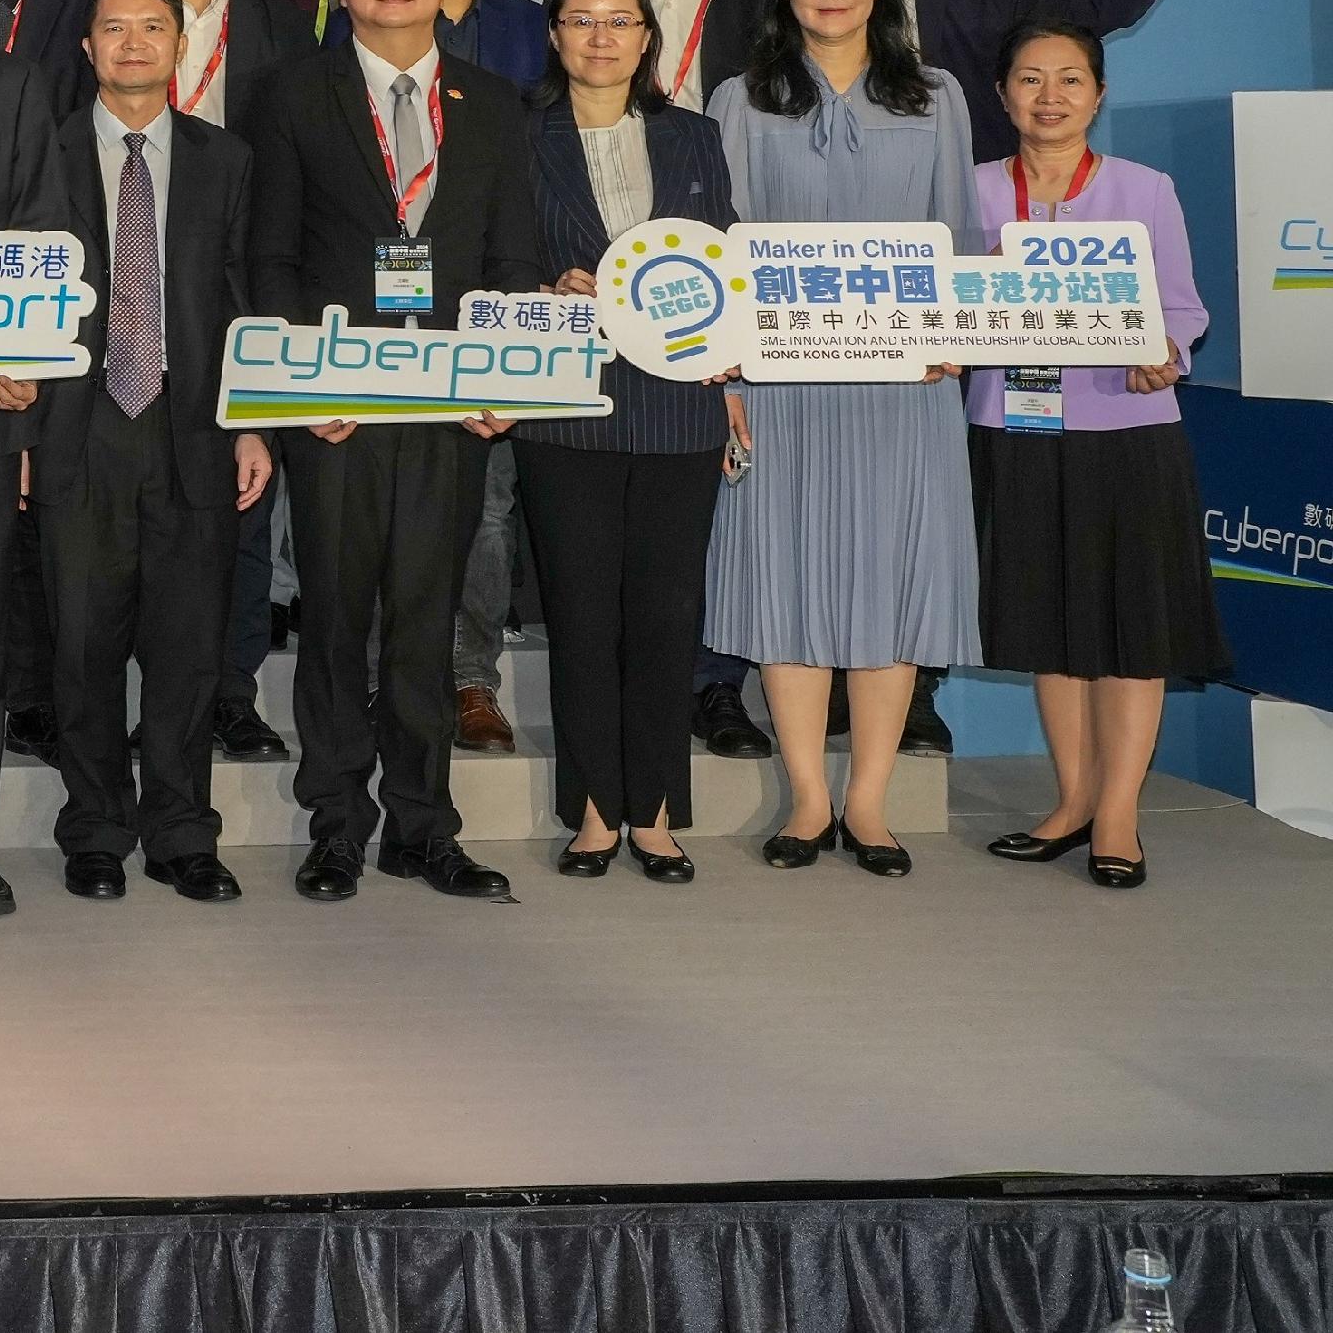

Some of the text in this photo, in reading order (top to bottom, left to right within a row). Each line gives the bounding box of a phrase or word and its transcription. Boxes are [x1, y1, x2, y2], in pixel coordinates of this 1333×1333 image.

[750, 238, 934, 260] Maker in China
[1021, 237, 1136, 265] 2024
[649, 276, 704, 300] SME
[755, 265, 1141, 304] 創客中國 香港分站賽
[468, 299, 596, 334] 數碼港
[647, 295, 711, 322] IEGC
[757, 308, 1145, 331] 國際中小企業創新創業大賽
[761, 336, 1147, 346] SME INNOVATION AND ENTREPRENEURSHIP GLOBAL CONTEST
[233, 314, 608, 399] Cyberport
[761, 350, 905, 360] HONG KONG CHAPTER
